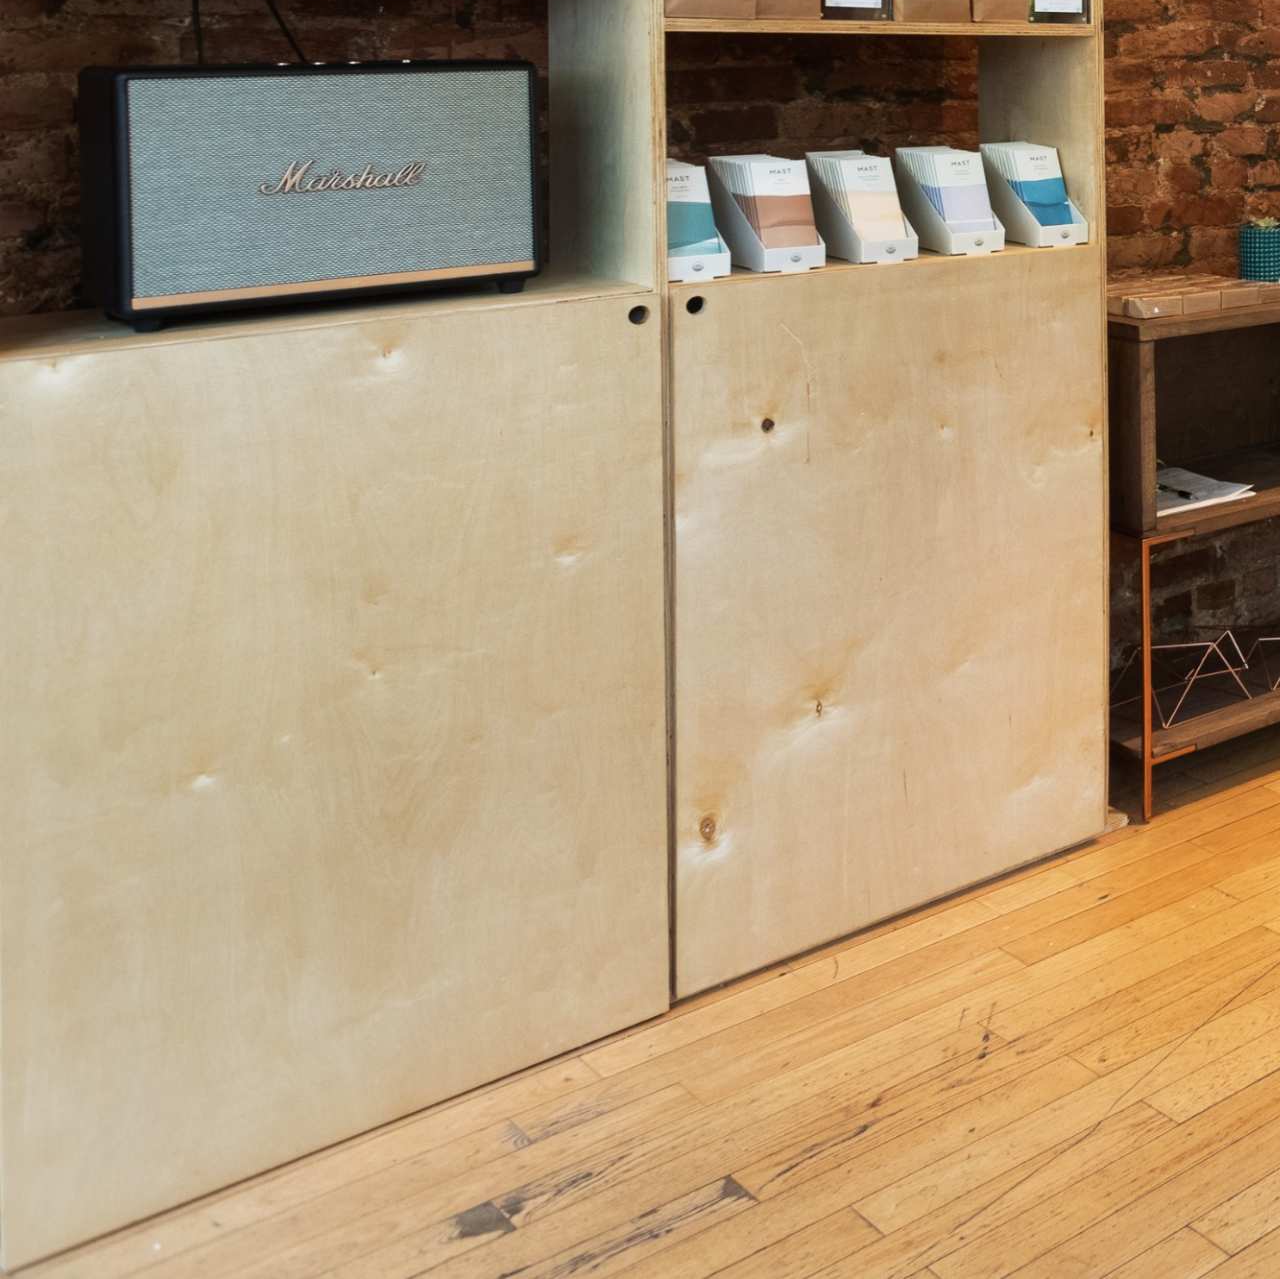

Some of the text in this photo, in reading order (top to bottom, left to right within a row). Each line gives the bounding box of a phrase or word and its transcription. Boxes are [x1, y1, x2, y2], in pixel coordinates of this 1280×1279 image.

[1029, 155, 1048, 163] MAST
[951, 159, 971, 168] MAST
[769, 167, 792, 175] MAST
[857, 164, 878, 172] MAST
[259, 160, 427, 196] Marshall
